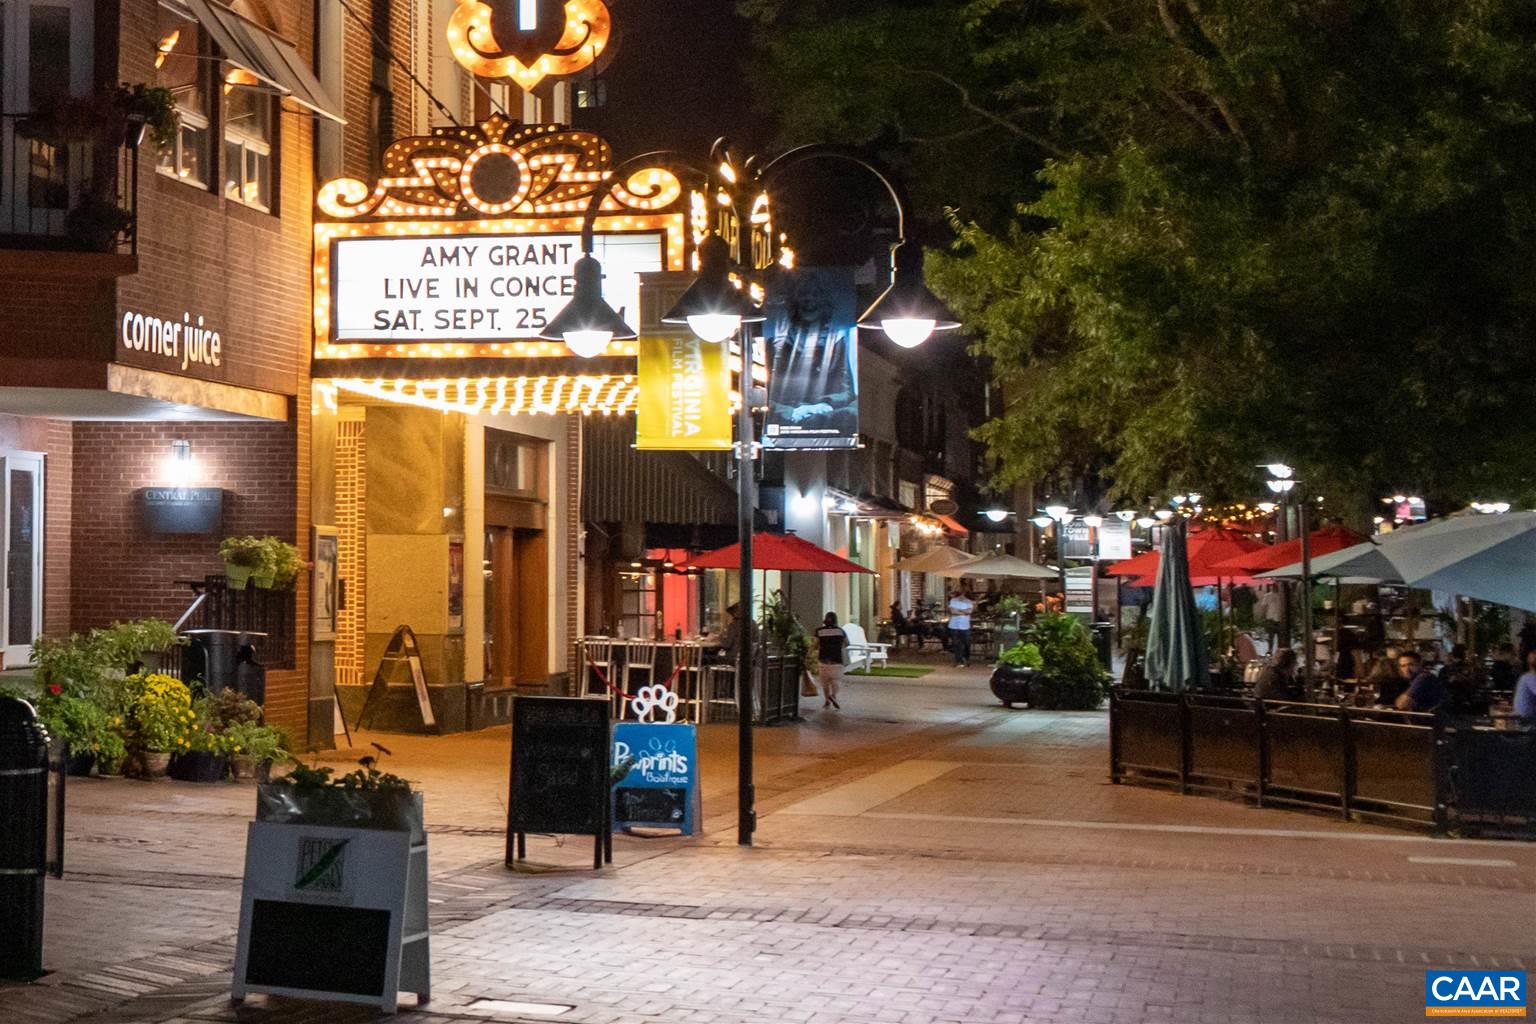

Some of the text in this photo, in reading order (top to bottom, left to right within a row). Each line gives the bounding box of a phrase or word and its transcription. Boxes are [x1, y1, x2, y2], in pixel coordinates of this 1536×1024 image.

[421, 243, 572, 267] AMY GRANT
[384, 275, 575, 299] LIVE IN CONCE
[374, 307, 547, 332] SAT. SEPT. 25
[123, 311, 221, 371] corner juice
[672, 337, 683, 369] FILM
[684, 339, 701, 437] VIRGINIA
[145, 489, 188, 500] CENTRAL
